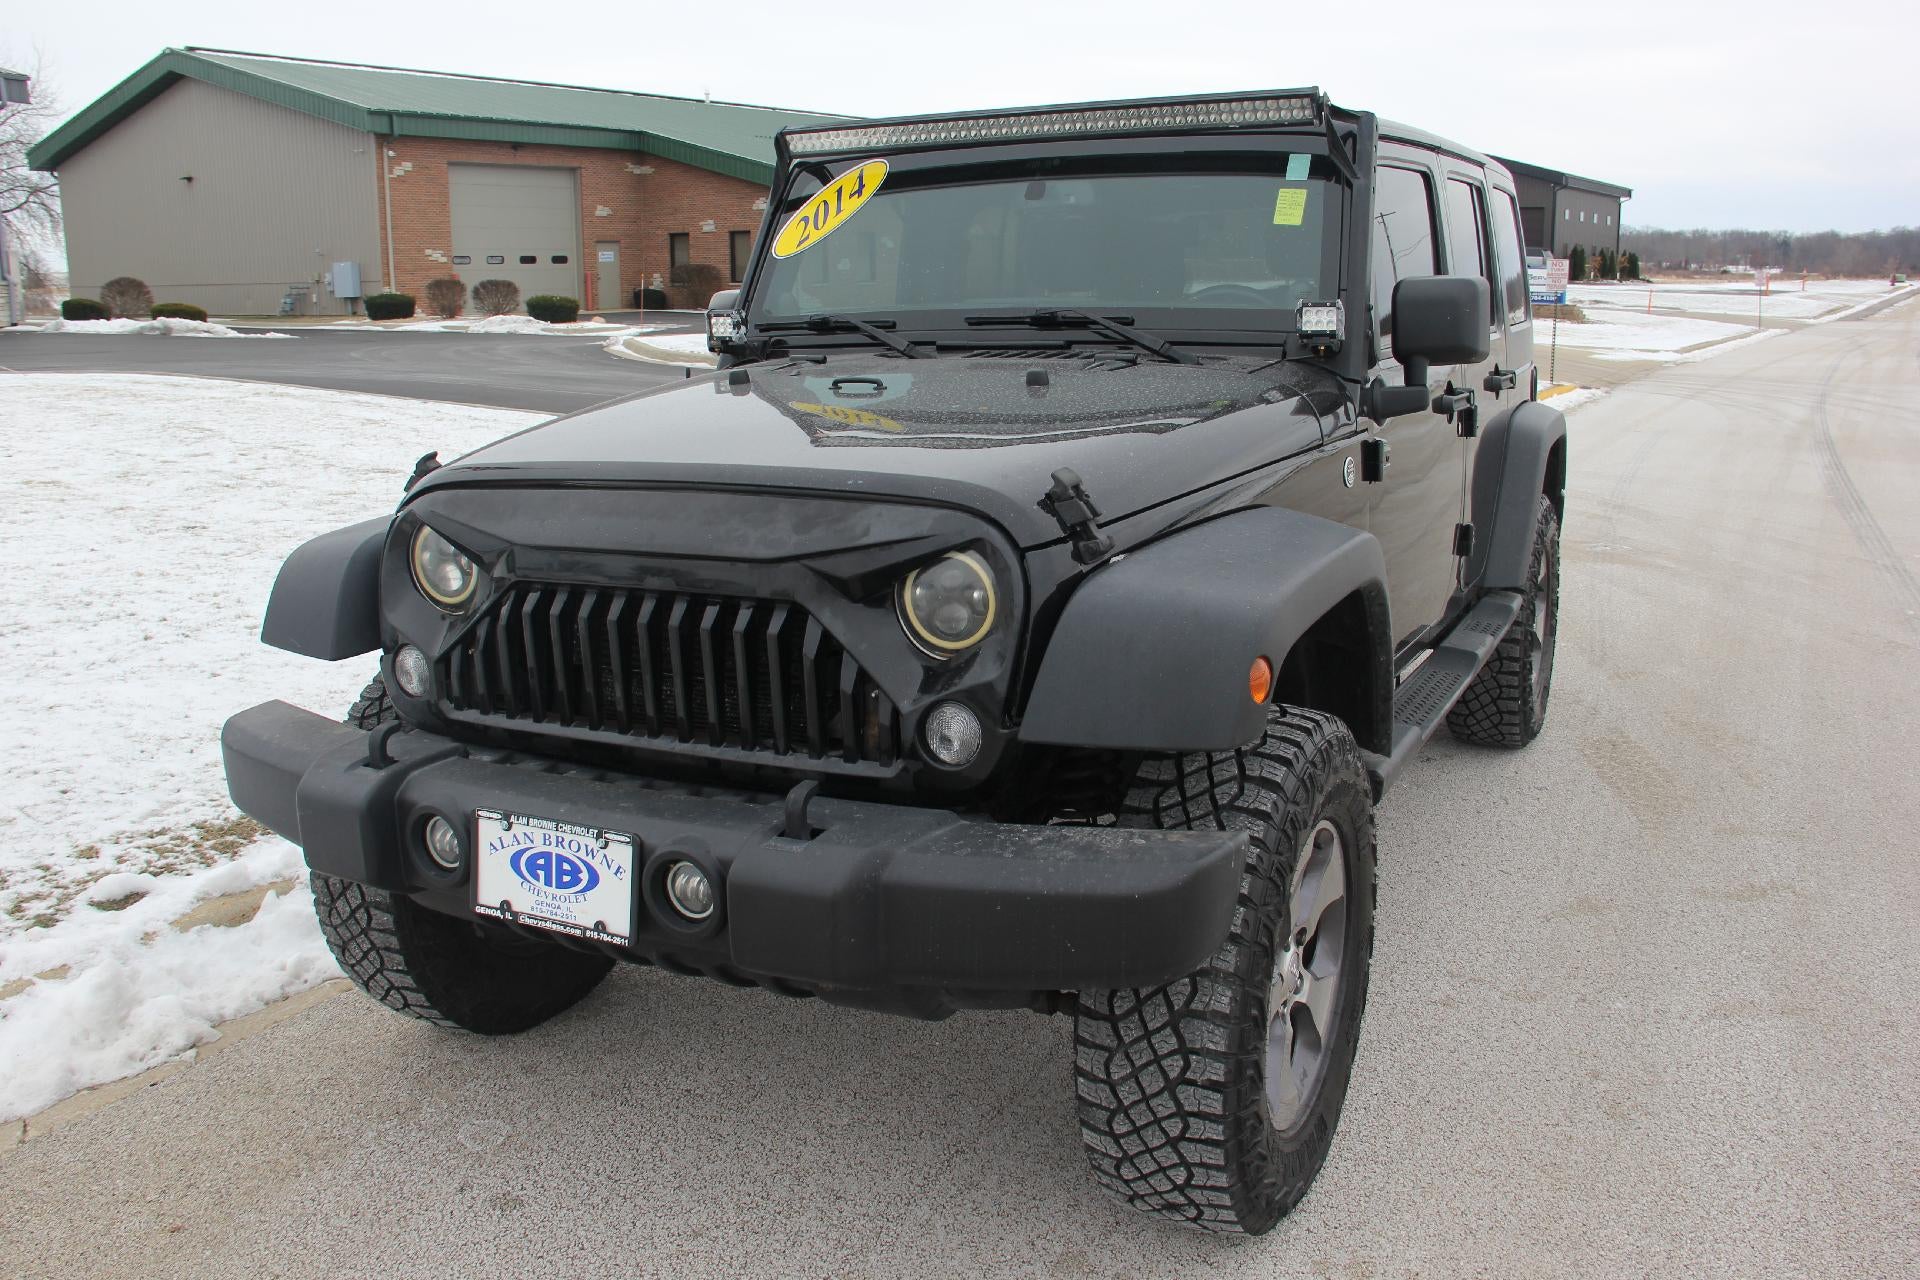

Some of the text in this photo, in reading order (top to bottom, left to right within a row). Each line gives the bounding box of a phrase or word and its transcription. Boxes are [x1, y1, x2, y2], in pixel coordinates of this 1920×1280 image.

[796, 168, 866, 249] 2014
[510, 814, 528, 825] ALAN
[528, 818, 557, 830] BROWNE
[558, 823, 599, 838] CHEVROLET
[489, 831, 627, 881] ALAN BROWNE
[524, 850, 585, 890] AB
[520, 880, 589, 905] CHEVROLET
[475, 905, 504, 919] GENOA,
[505, 911, 513, 920] IL
[586, 929, 629, 946] 815-784-2511
[530, 905, 578, 921] 815-784-2511
